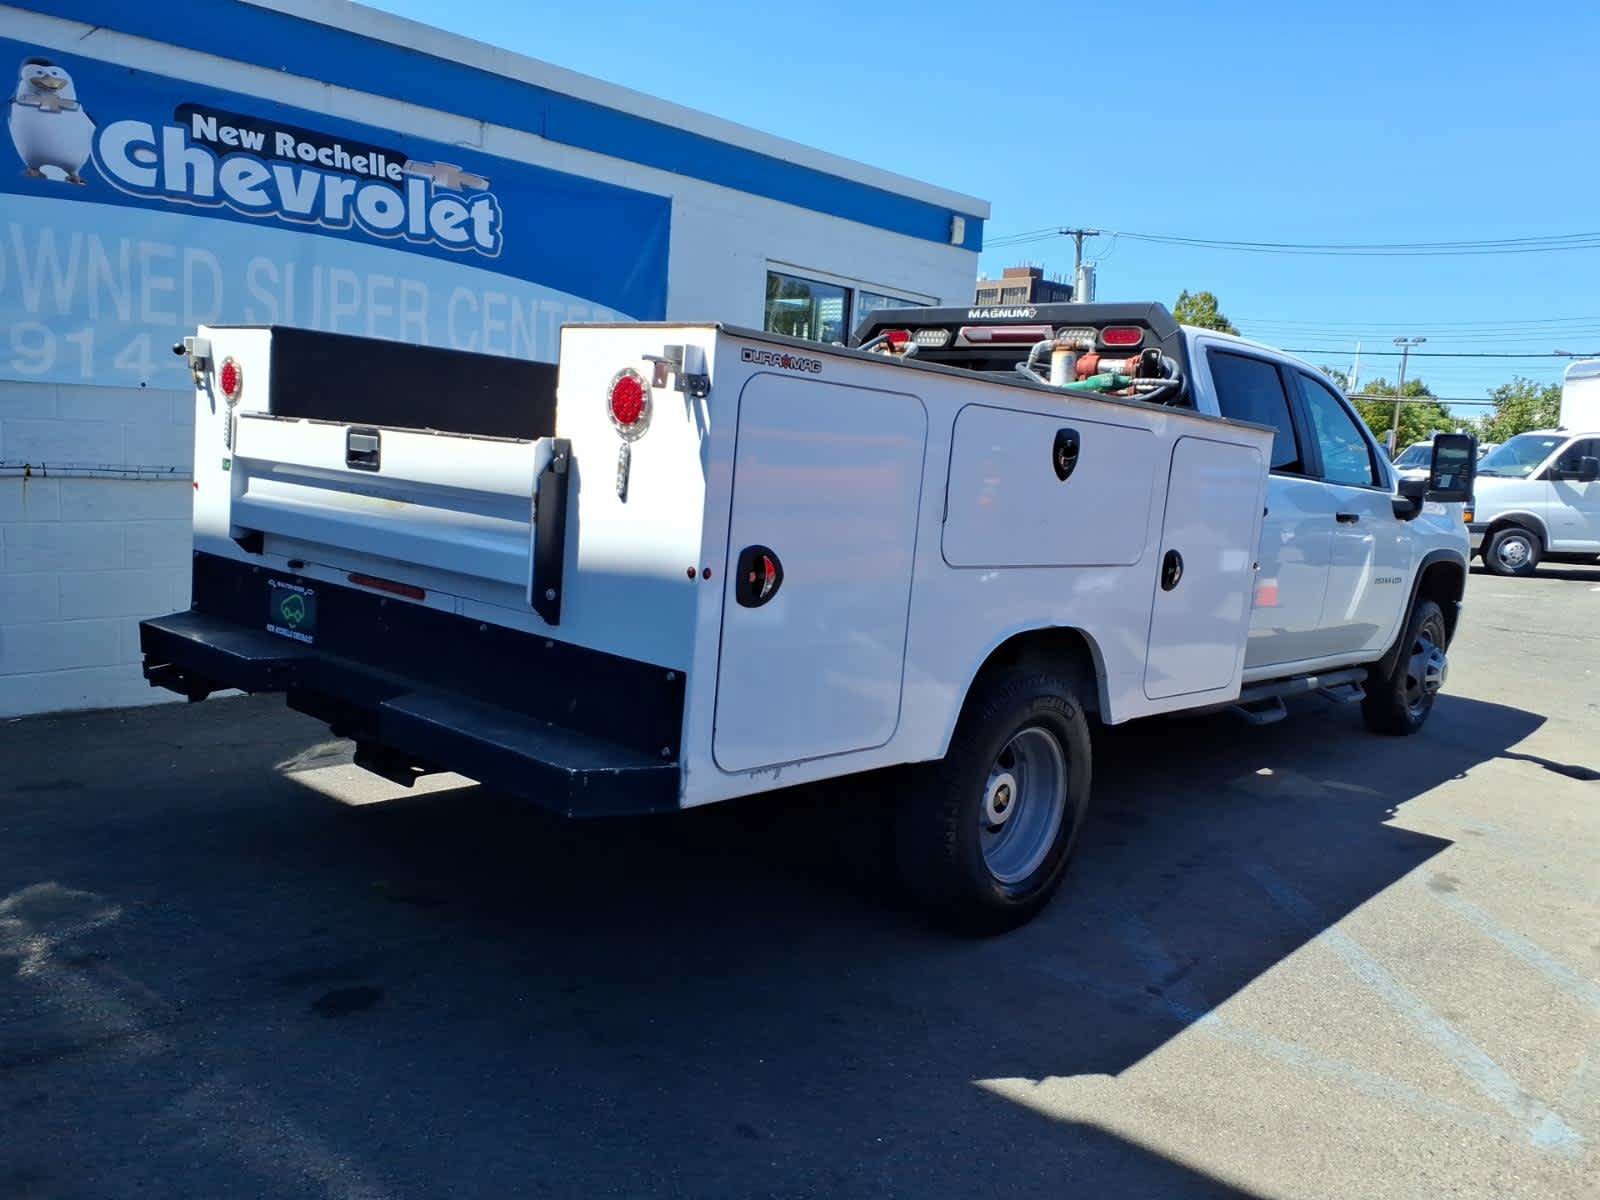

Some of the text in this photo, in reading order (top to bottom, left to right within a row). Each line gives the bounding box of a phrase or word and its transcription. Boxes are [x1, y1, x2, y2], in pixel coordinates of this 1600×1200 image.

[99, 120, 495, 249] Chevrolet
[192, 113, 403, 181] New Rochelle
[243, 256, 430, 345] SUPER
[447, 287, 614, 362] CENT
[968, 307, 1030, 319] MAGNUM
